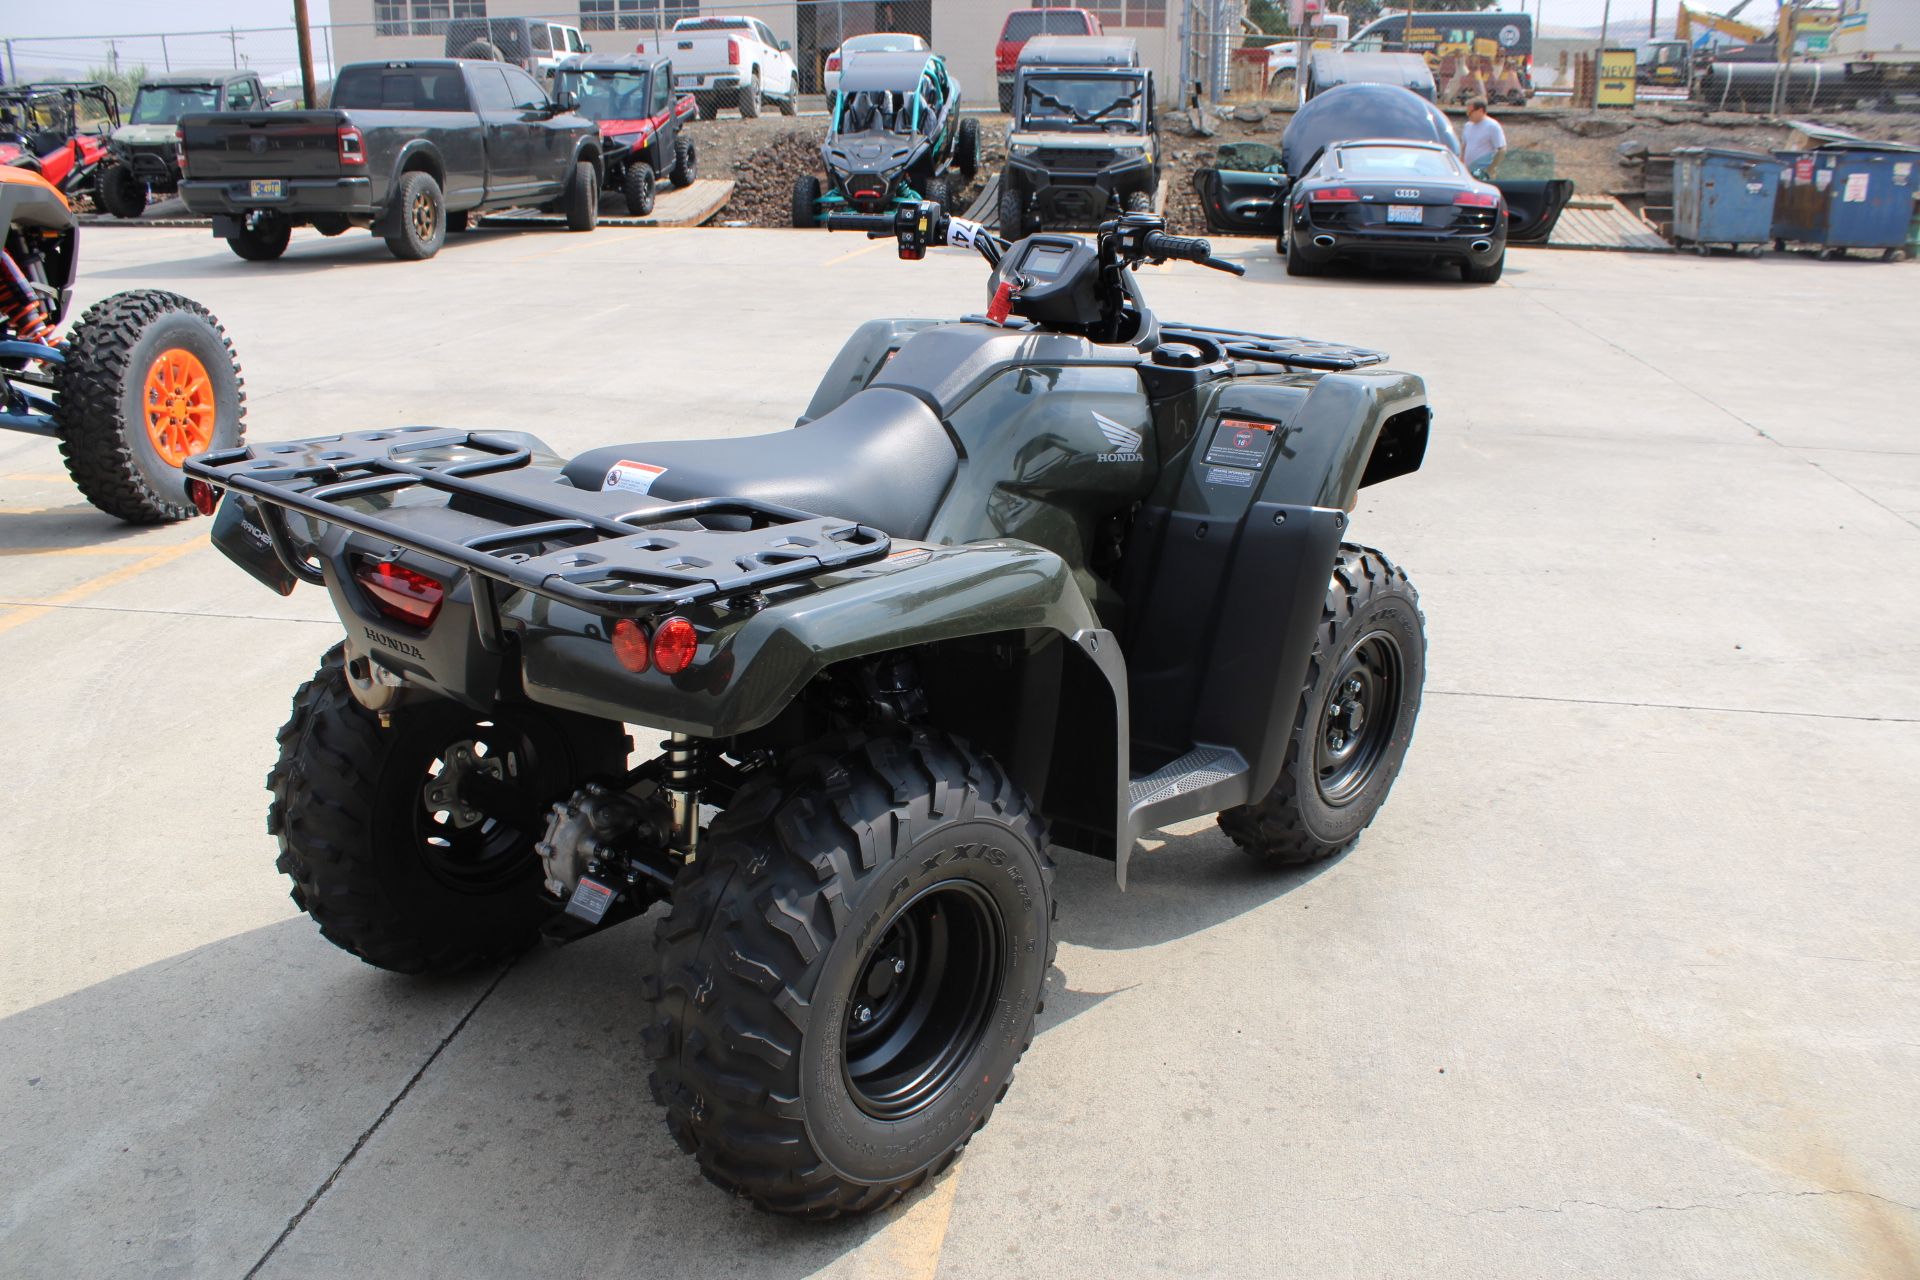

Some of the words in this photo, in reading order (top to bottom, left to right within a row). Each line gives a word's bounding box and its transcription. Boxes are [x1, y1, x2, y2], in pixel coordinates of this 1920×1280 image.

[1602, 66, 1632, 77] NEW
[1097, 453, 1144, 463] HONDA
[240, 519, 273, 547] RANCHER
[364, 626, 426, 661] HONDA
[855, 842, 1008, 958] MAXXIS
